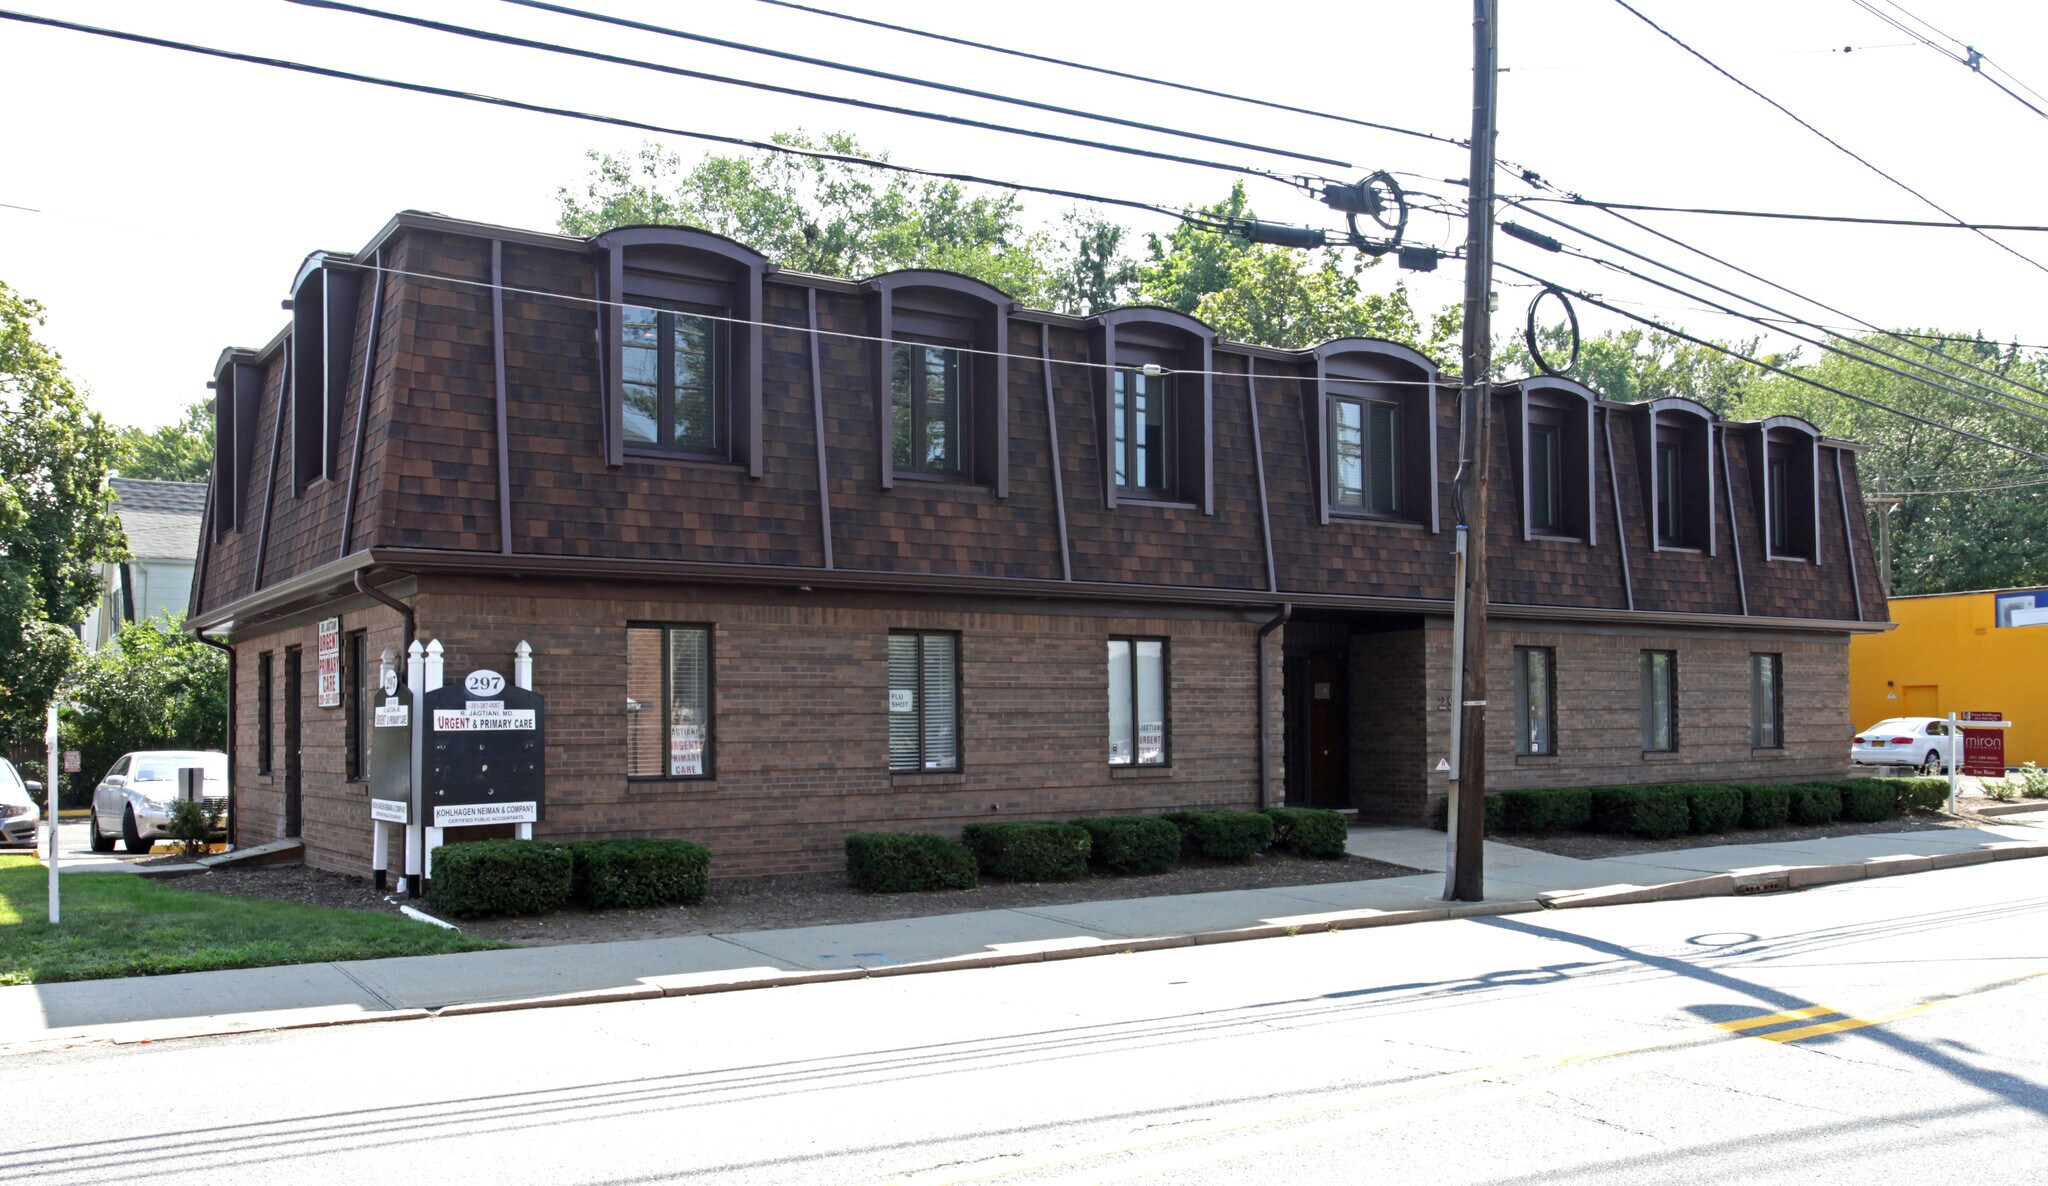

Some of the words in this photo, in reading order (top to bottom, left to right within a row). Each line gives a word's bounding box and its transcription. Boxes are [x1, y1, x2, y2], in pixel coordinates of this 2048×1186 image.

[320, 632, 339, 651] URGENT
[320, 656, 339, 675] PRIMARY
[323, 675, 336, 692] CARE
[387, 675, 396, 689] 297
[469, 677, 501, 690] 297
[438, 716, 470, 729] URGENT
[472, 720, 478, 729] &
[480, 719, 512, 729] PRIMARY
[514, 718, 533, 729] CARE
[1965, 735, 2001, 747] miron
[675, 765, 697, 775] CARE
[436, 807, 476, 818] KOHLHAGEN
[477, 806, 500, 815] NEIMAN
[501, 806, 506, 814] &
[506, 804, 534, 814] COMPANY
